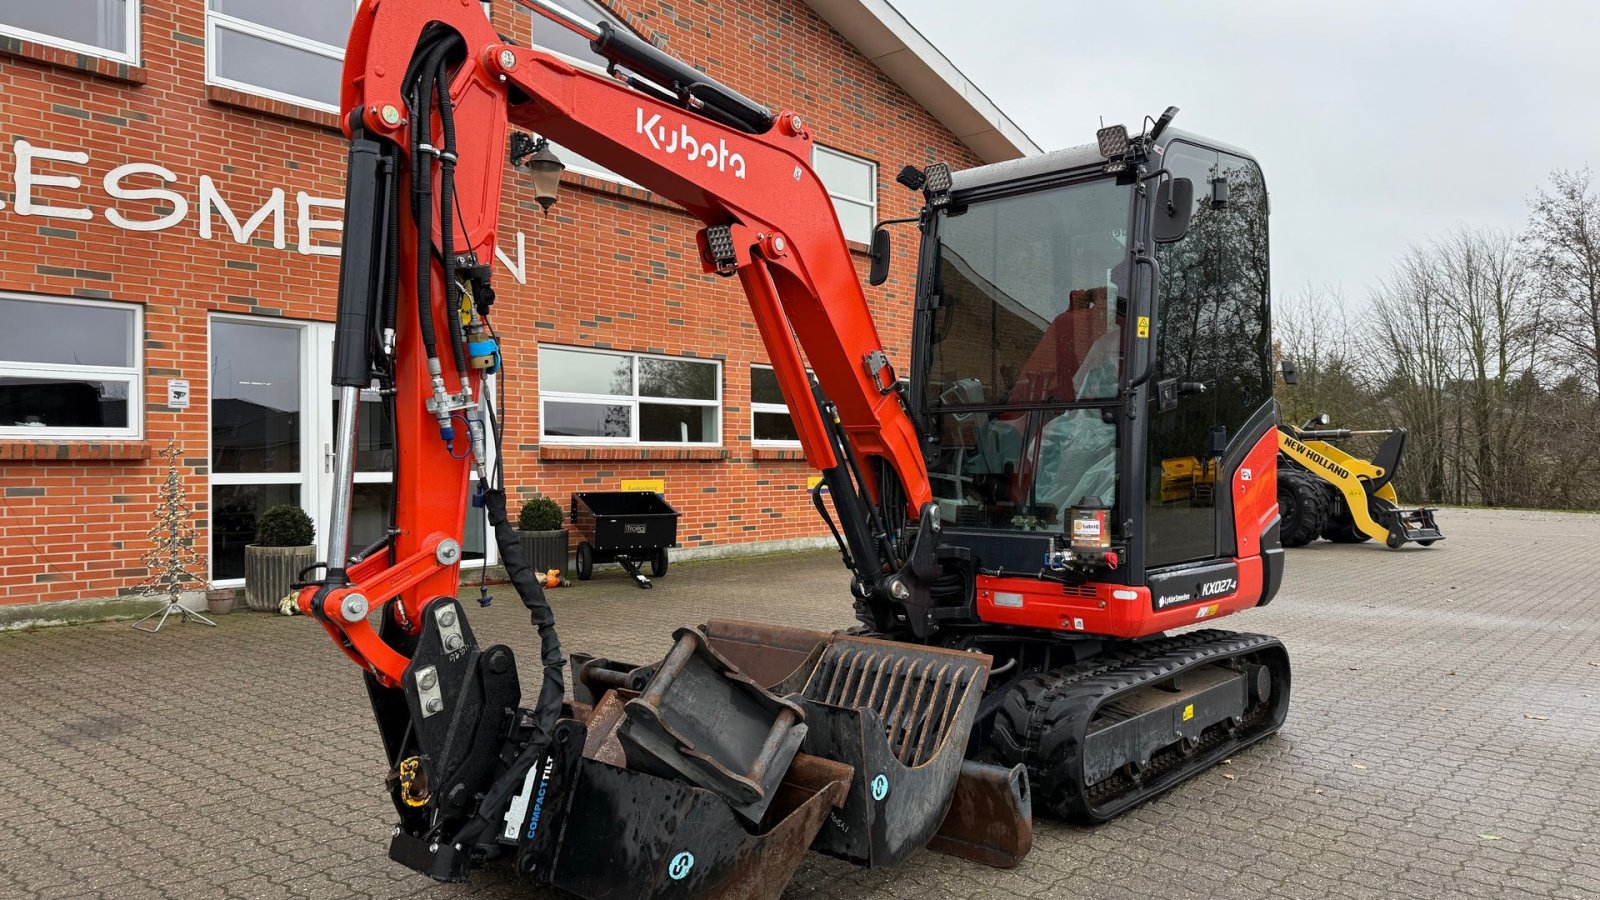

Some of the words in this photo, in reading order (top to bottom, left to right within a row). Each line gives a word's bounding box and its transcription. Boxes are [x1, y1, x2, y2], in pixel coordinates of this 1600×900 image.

[636, 107, 746, 180] Kubota
[1283, 436, 1306, 454] NEW
[1305, 449, 1349, 479] HOLLAND
